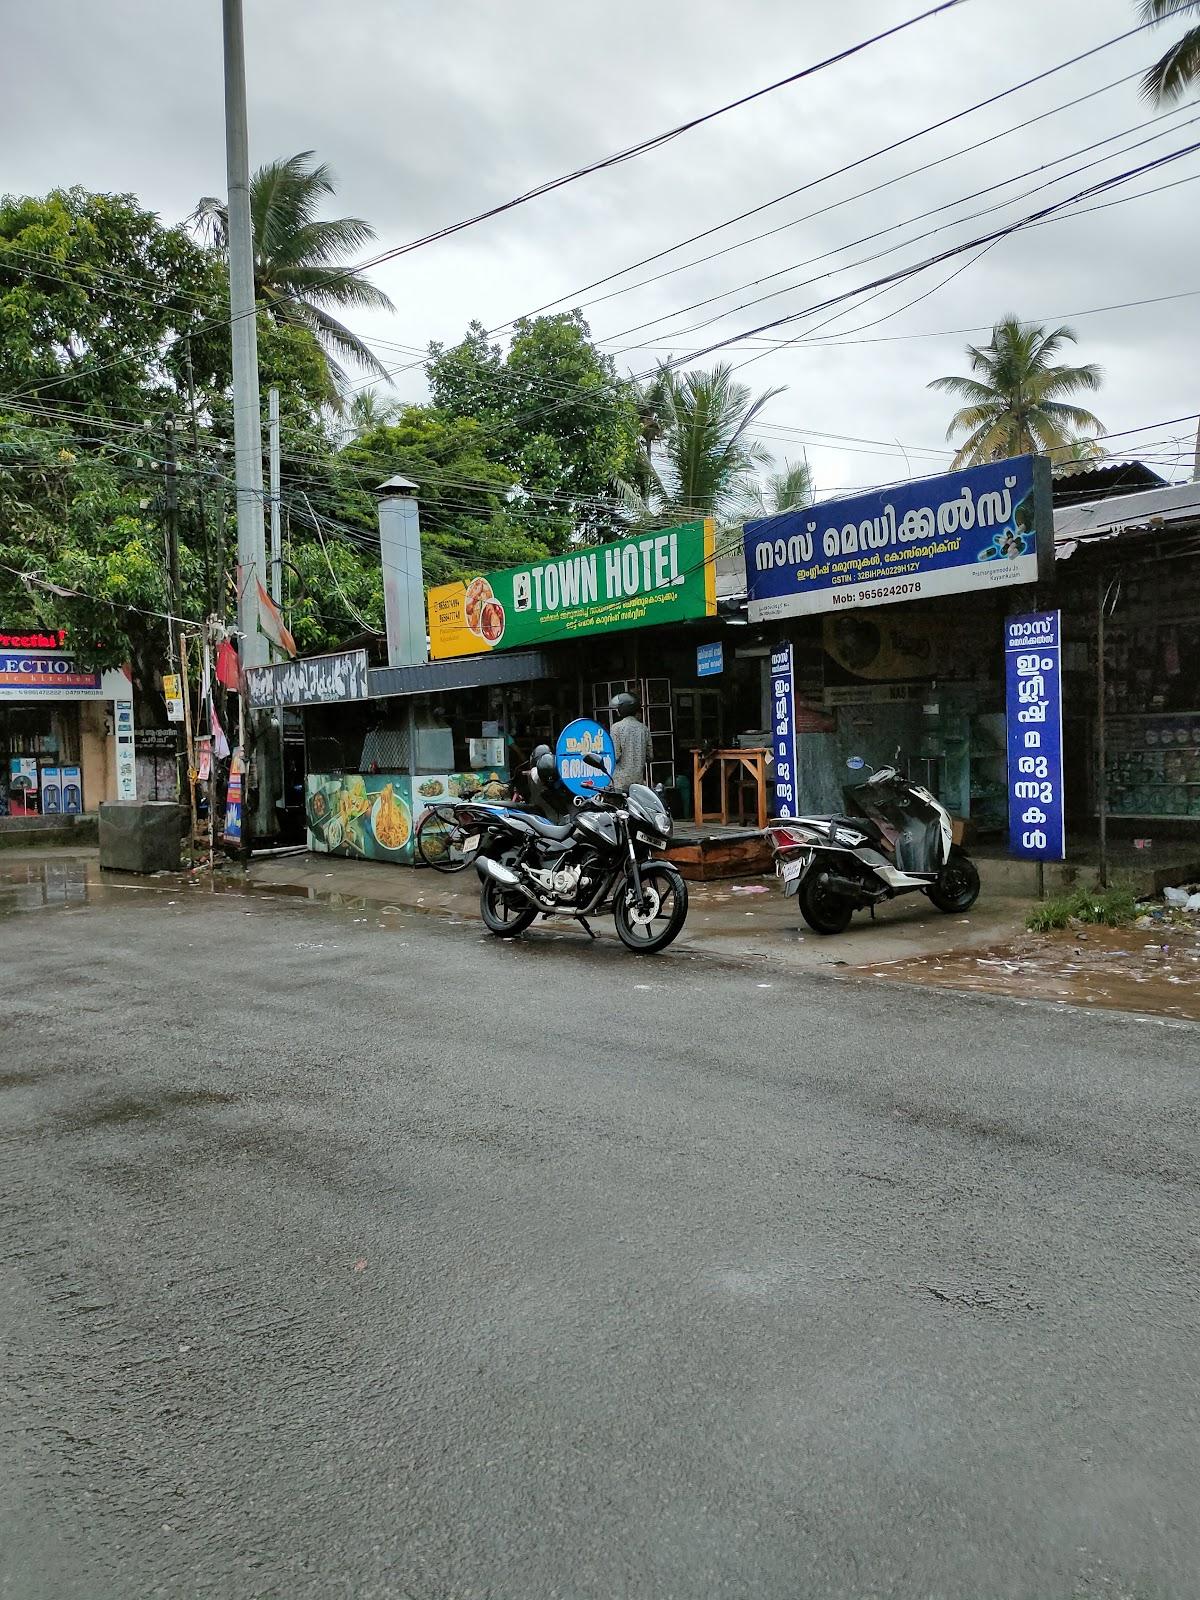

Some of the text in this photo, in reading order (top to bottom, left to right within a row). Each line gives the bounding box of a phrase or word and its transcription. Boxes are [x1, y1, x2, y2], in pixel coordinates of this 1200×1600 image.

[756, 476, 1017, 571] നാസ് മെഡിക്കൽസ്
[532, 534, 685, 613] TOWN HOTEL
[797, 562, 830, 581] ഇംഗ്ലീഷ്
[832, 574, 852, 584] GSTIN
[833, 581, 921, 605] Mob: 9656242078
[1009, 616, 1054, 636] നാസ്
[776, 742, 792, 818] മരുന്നുക
